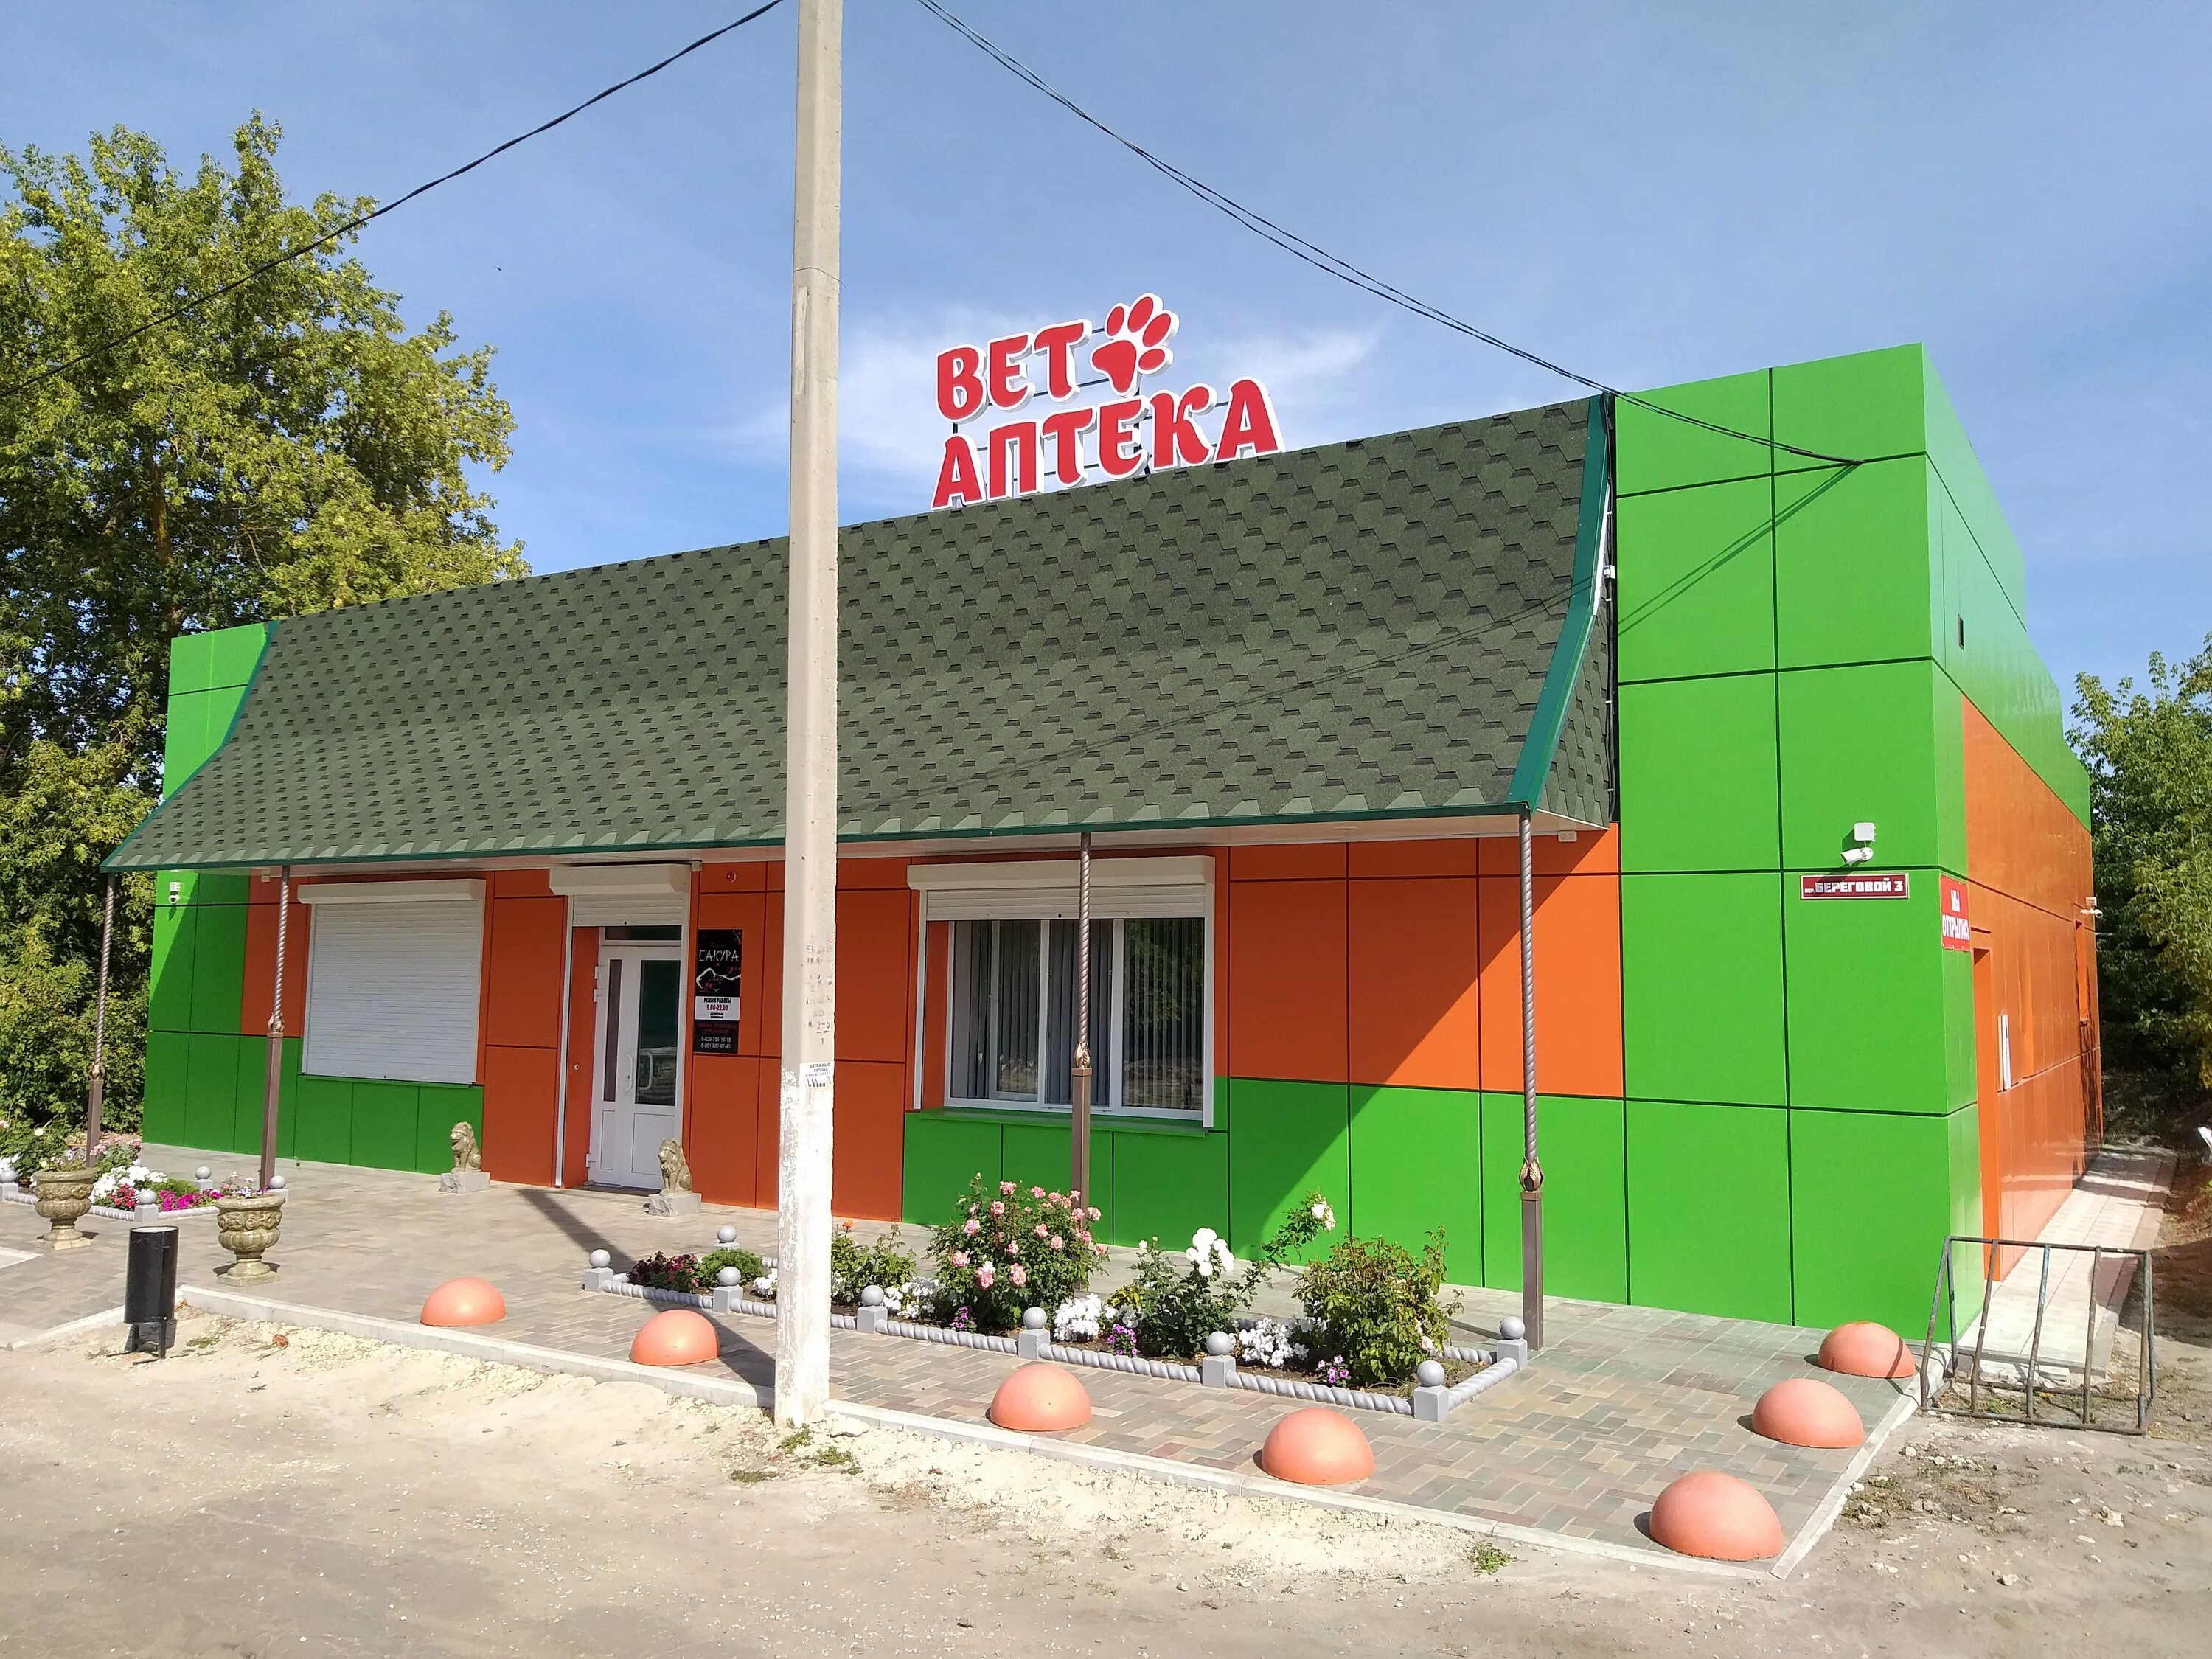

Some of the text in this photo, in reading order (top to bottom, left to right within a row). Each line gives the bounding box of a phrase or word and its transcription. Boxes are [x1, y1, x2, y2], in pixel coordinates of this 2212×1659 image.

[936, 319, 1090, 422] ВЕТ
[931, 378, 1283, 510] АПТЕКА
[1815, 877, 1891, 893] БЕРЕГОВОЙ
[1894, 880, 1904, 892] 3
[699, 950, 739, 962] САКУРА
